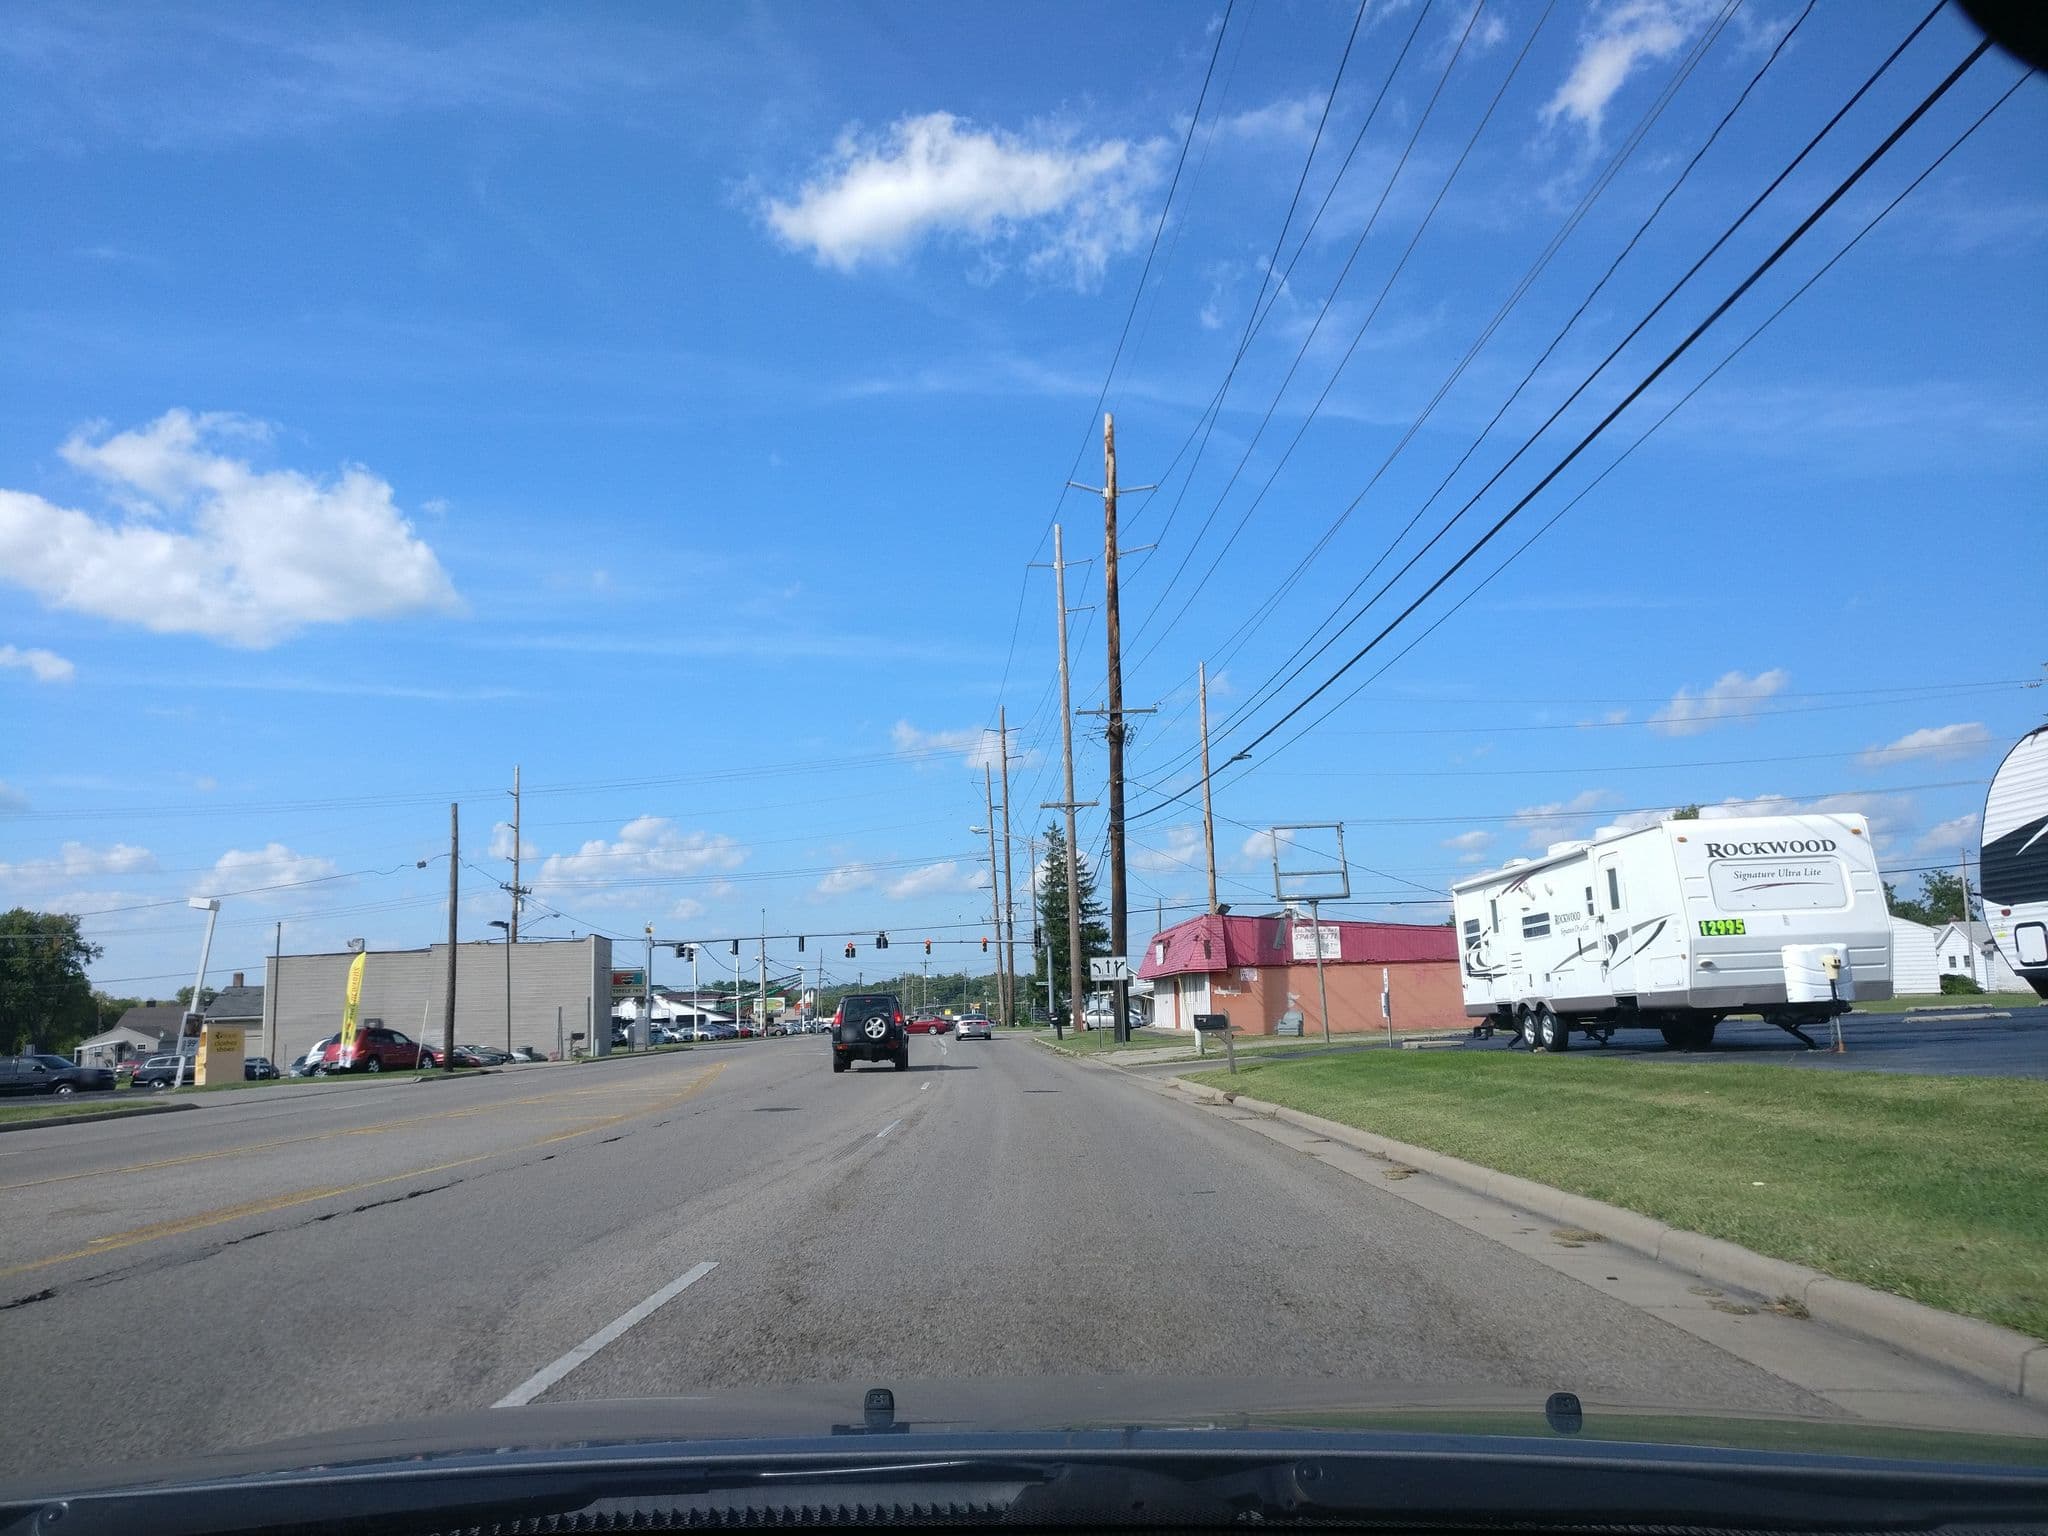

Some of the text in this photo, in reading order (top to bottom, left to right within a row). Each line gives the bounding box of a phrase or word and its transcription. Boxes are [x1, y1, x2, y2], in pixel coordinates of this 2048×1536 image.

[1704, 839, 1837, 858] ROCKWOOD
[1733, 868, 1822, 881] Signature Ultra Lite
[1555, 912, 1580, 925] ROCKWOOD
[1701, 919, 1744, 936] 12995
[1295, 933, 1338, 941] SPAGETTI
